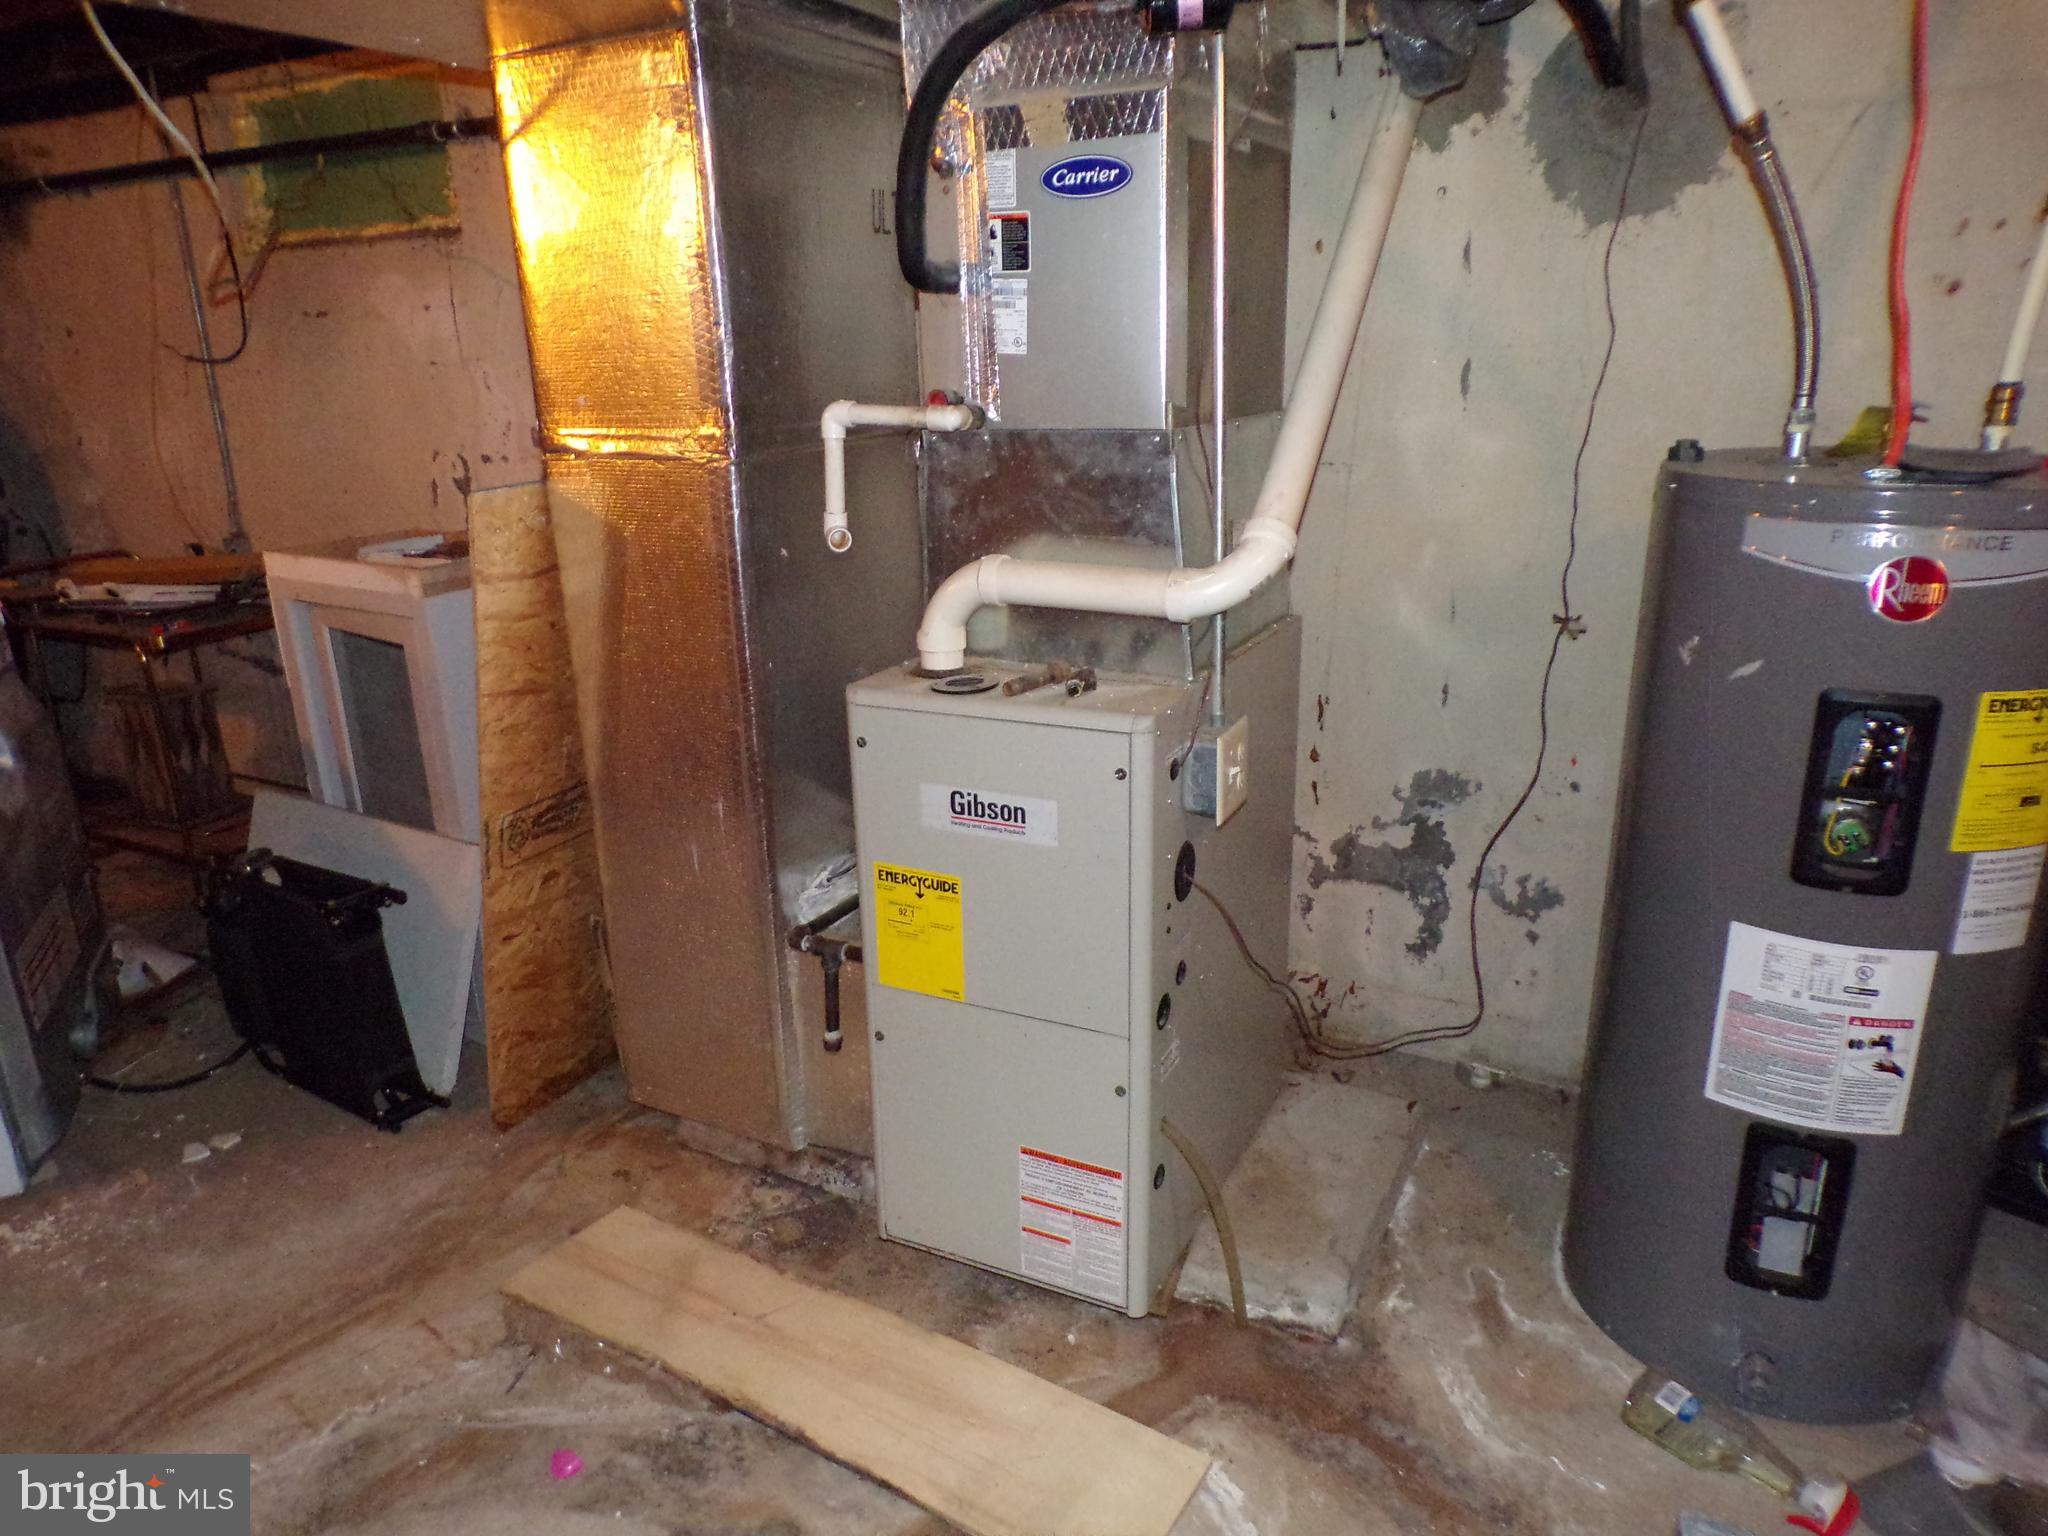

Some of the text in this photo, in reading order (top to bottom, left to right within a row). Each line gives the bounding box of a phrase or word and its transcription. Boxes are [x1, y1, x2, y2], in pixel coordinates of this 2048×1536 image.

[1052, 166, 1120, 187] Carrier
[1831, 528, 2015, 552] PRFOANCE
[1876, 556, 1945, 612] Rheem
[950, 790, 1027, 824] Gibson
[877, 868, 960, 894] ENERGYGUIDE
[898, 907, 915, 918] 92.1
